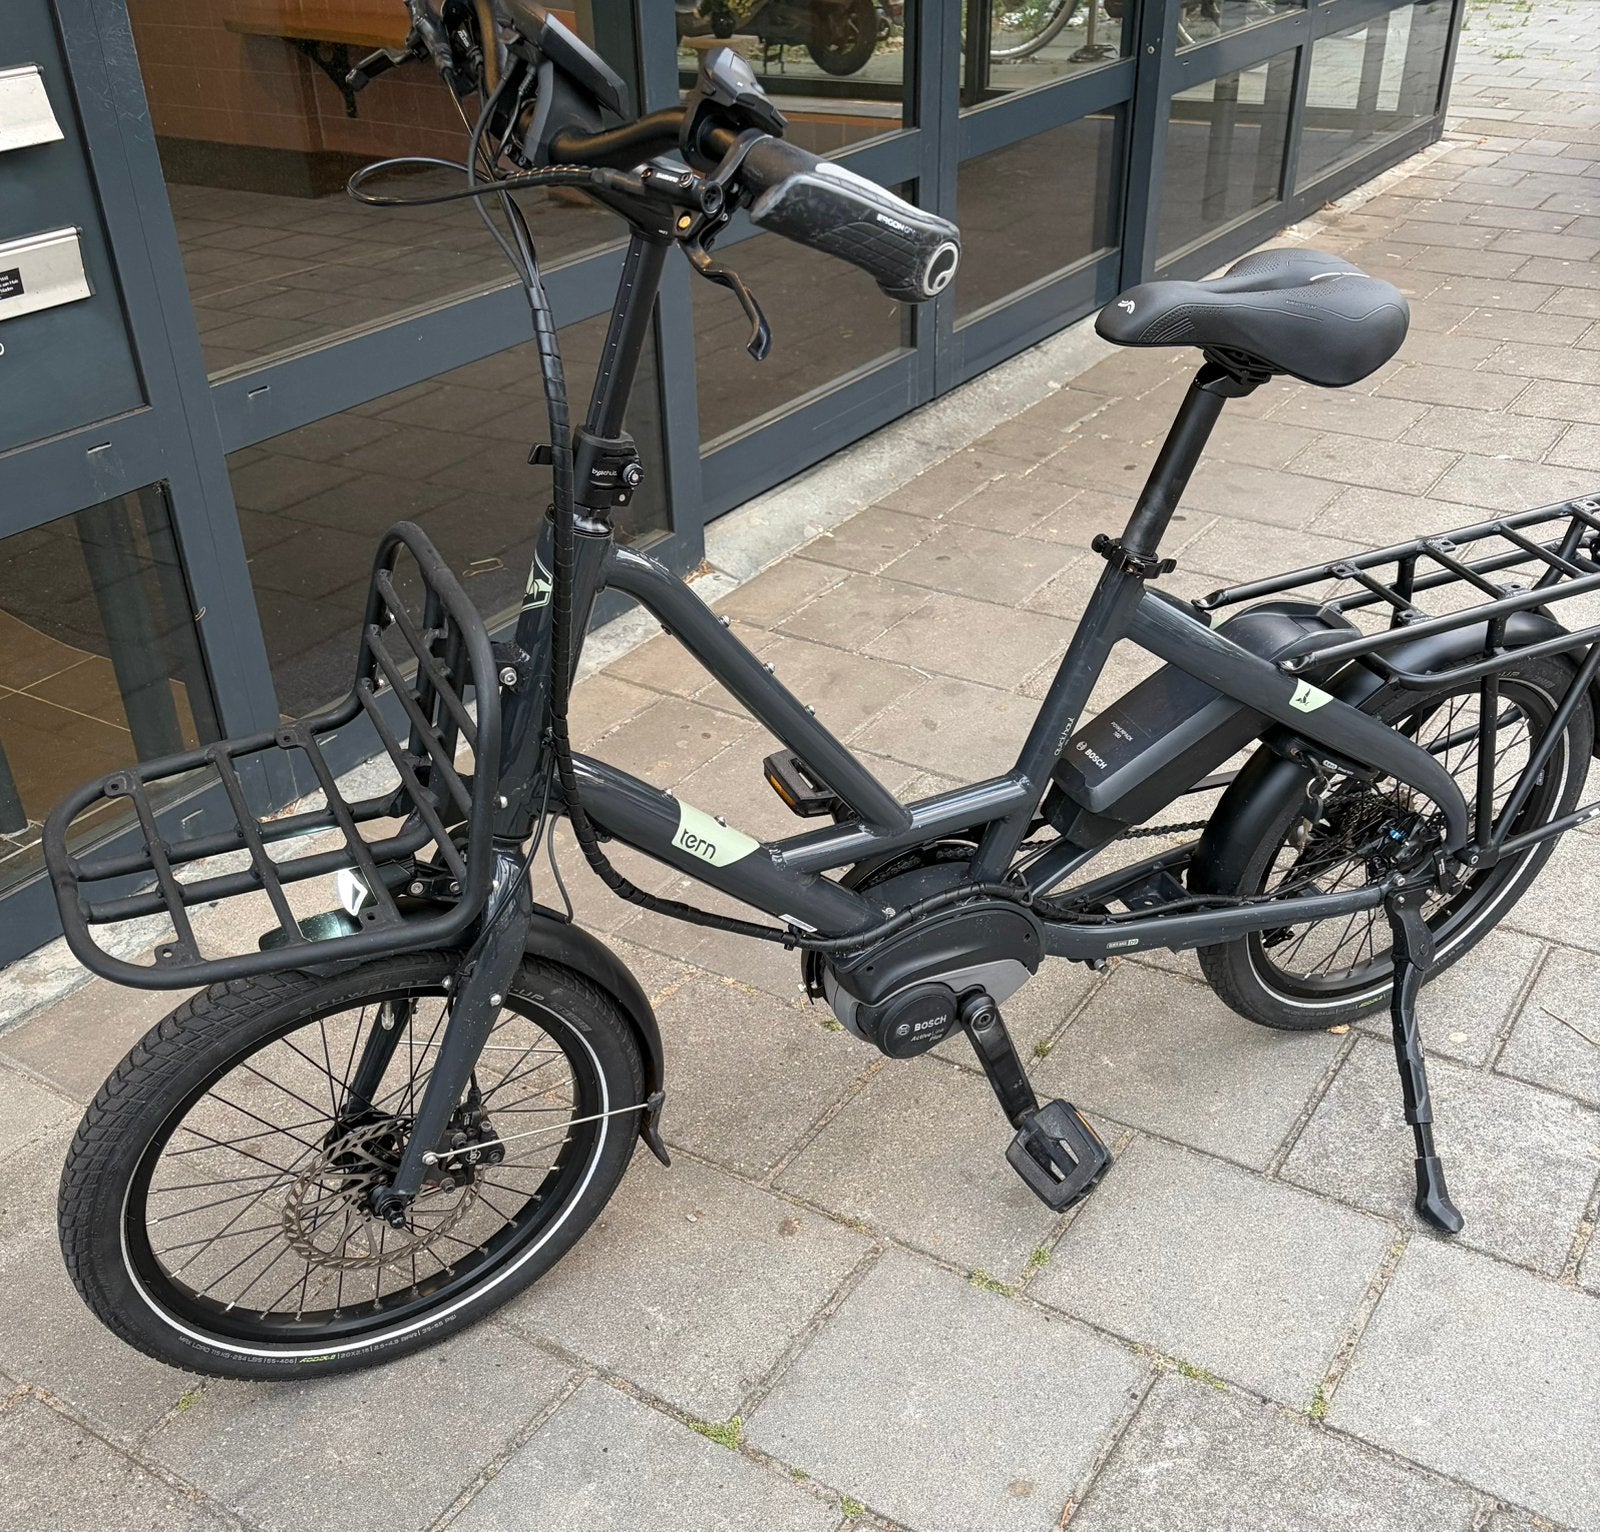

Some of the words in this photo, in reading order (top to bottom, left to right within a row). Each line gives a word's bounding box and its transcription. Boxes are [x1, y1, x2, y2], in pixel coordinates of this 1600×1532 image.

[1085, 748, 1108, 769] BOSCH
[680, 828, 716, 859] tern
[914, 1014, 947, 1032] BOSCH
